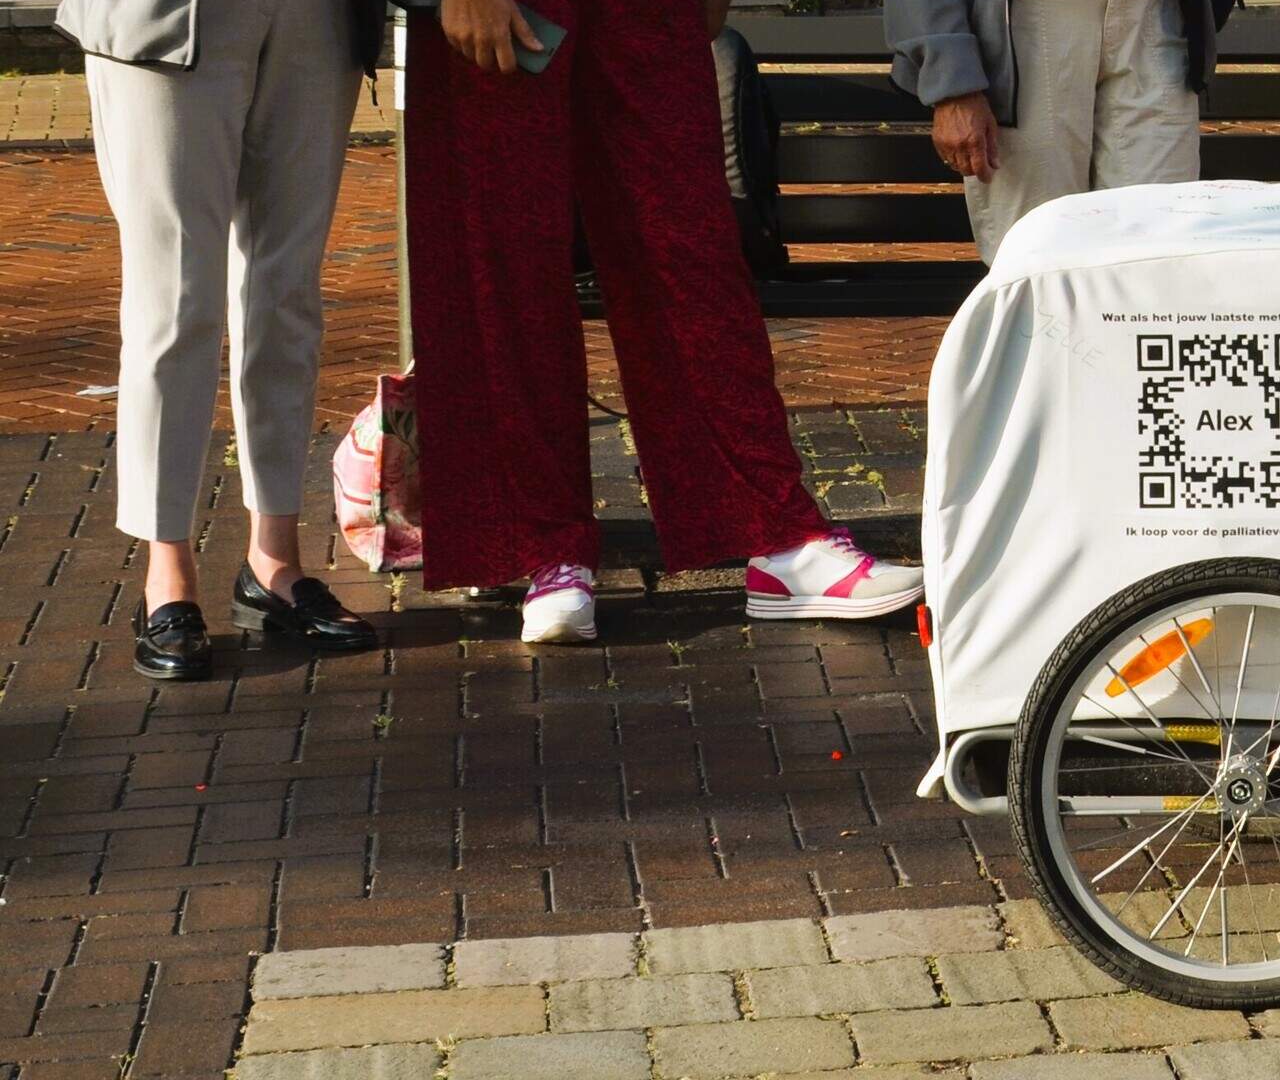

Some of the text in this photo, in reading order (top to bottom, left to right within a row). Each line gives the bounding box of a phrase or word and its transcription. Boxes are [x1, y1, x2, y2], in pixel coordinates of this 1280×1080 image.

[1102, 312, 1126, 322] Wat
[1130, 313, 1149, 322] als
[1152, 313, 1173, 322] het
[1176, 313, 1207, 324] jouw
[1211, 313, 1255, 322] laatste
[1196, 409, 1253, 431] Alex
[1126, 527, 1137, 536] Ik
[1141, 527, 1168, 538] loop
[1172, 528, 1199, 536] voor
[1202, 527, 1218, 536] de
